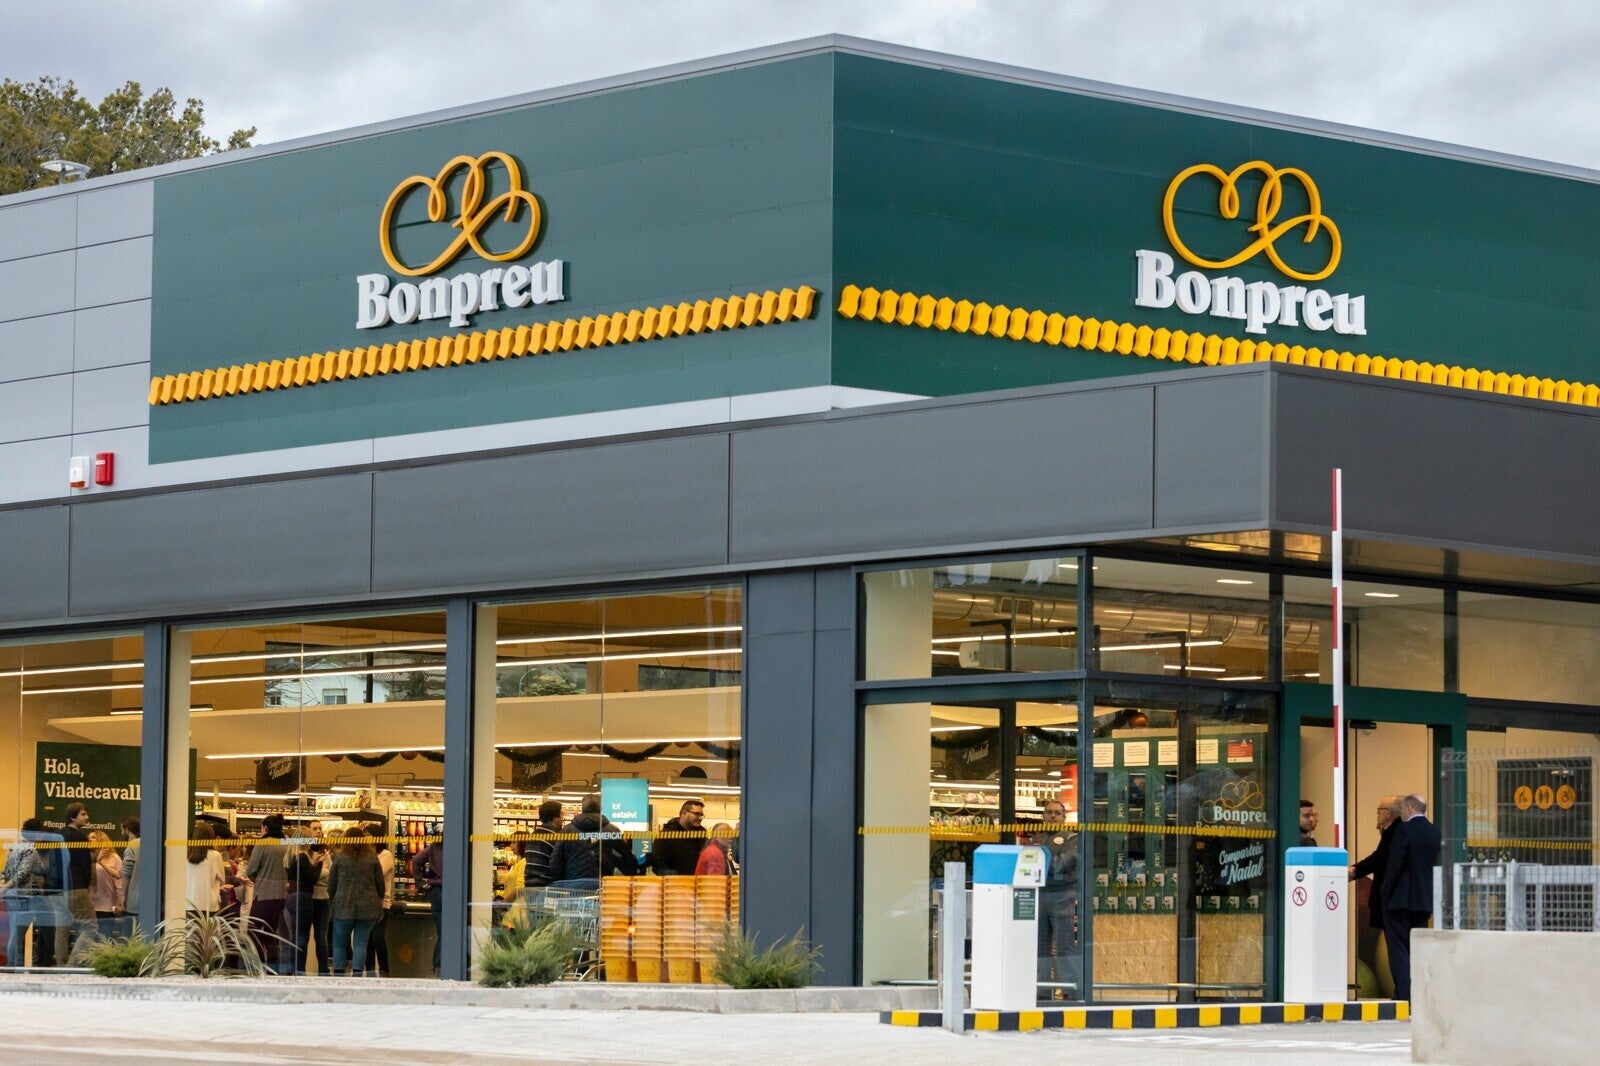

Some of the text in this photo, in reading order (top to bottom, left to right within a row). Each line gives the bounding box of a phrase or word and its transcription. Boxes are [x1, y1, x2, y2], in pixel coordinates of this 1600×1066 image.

[356, 259, 564, 329] Bonpreu
[1135, 249, 1366, 335] Bonpreu
[44, 758, 84, 778] Hola,
[44, 782, 141, 800] Viladecavall
[611, 811, 637, 819] estalvi
[579, 831, 622, 840] SUPERMERCAT
[1226, 856, 1265, 885] Nadal
